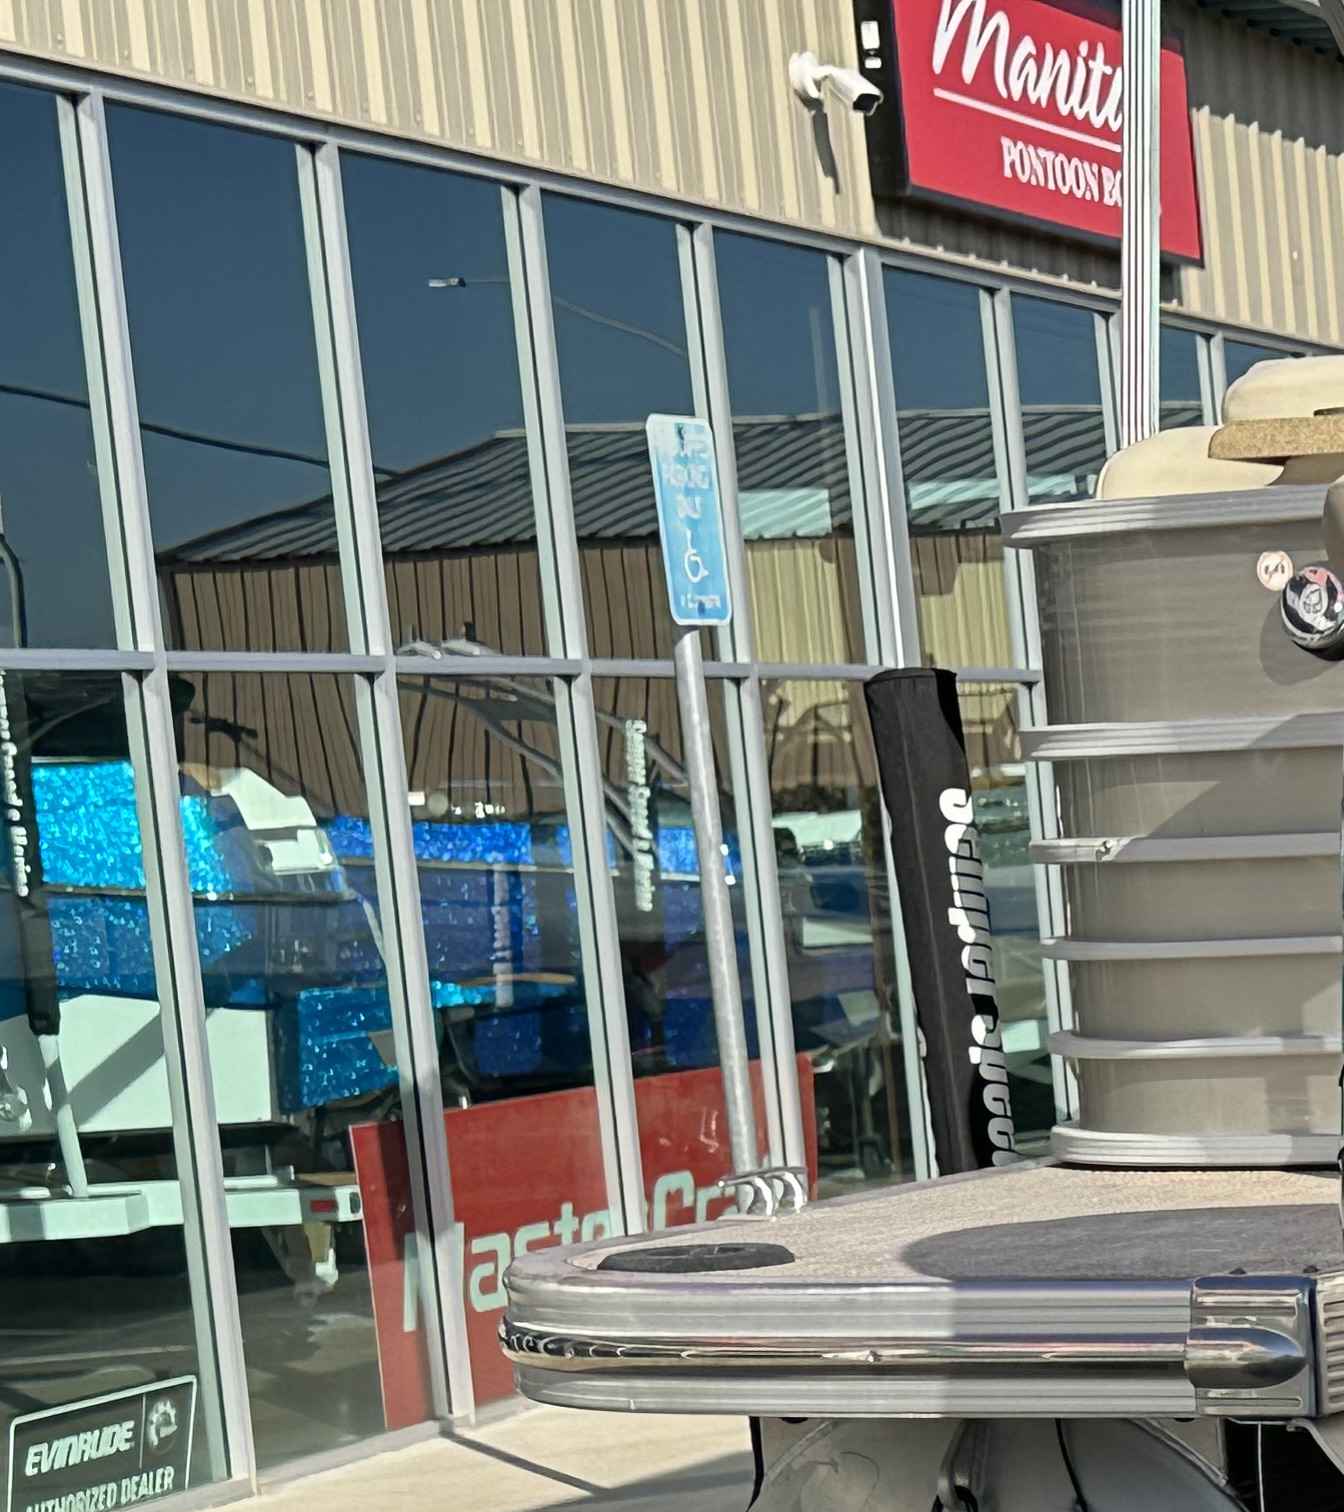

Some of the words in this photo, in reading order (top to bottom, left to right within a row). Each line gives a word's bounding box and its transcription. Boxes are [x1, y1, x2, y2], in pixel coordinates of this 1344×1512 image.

[1000, 136, 1099, 202] PONTOON
[24, 1420, 136, 1477] EVINRUDE
[120, 1466, 176, 1505] DEALER
